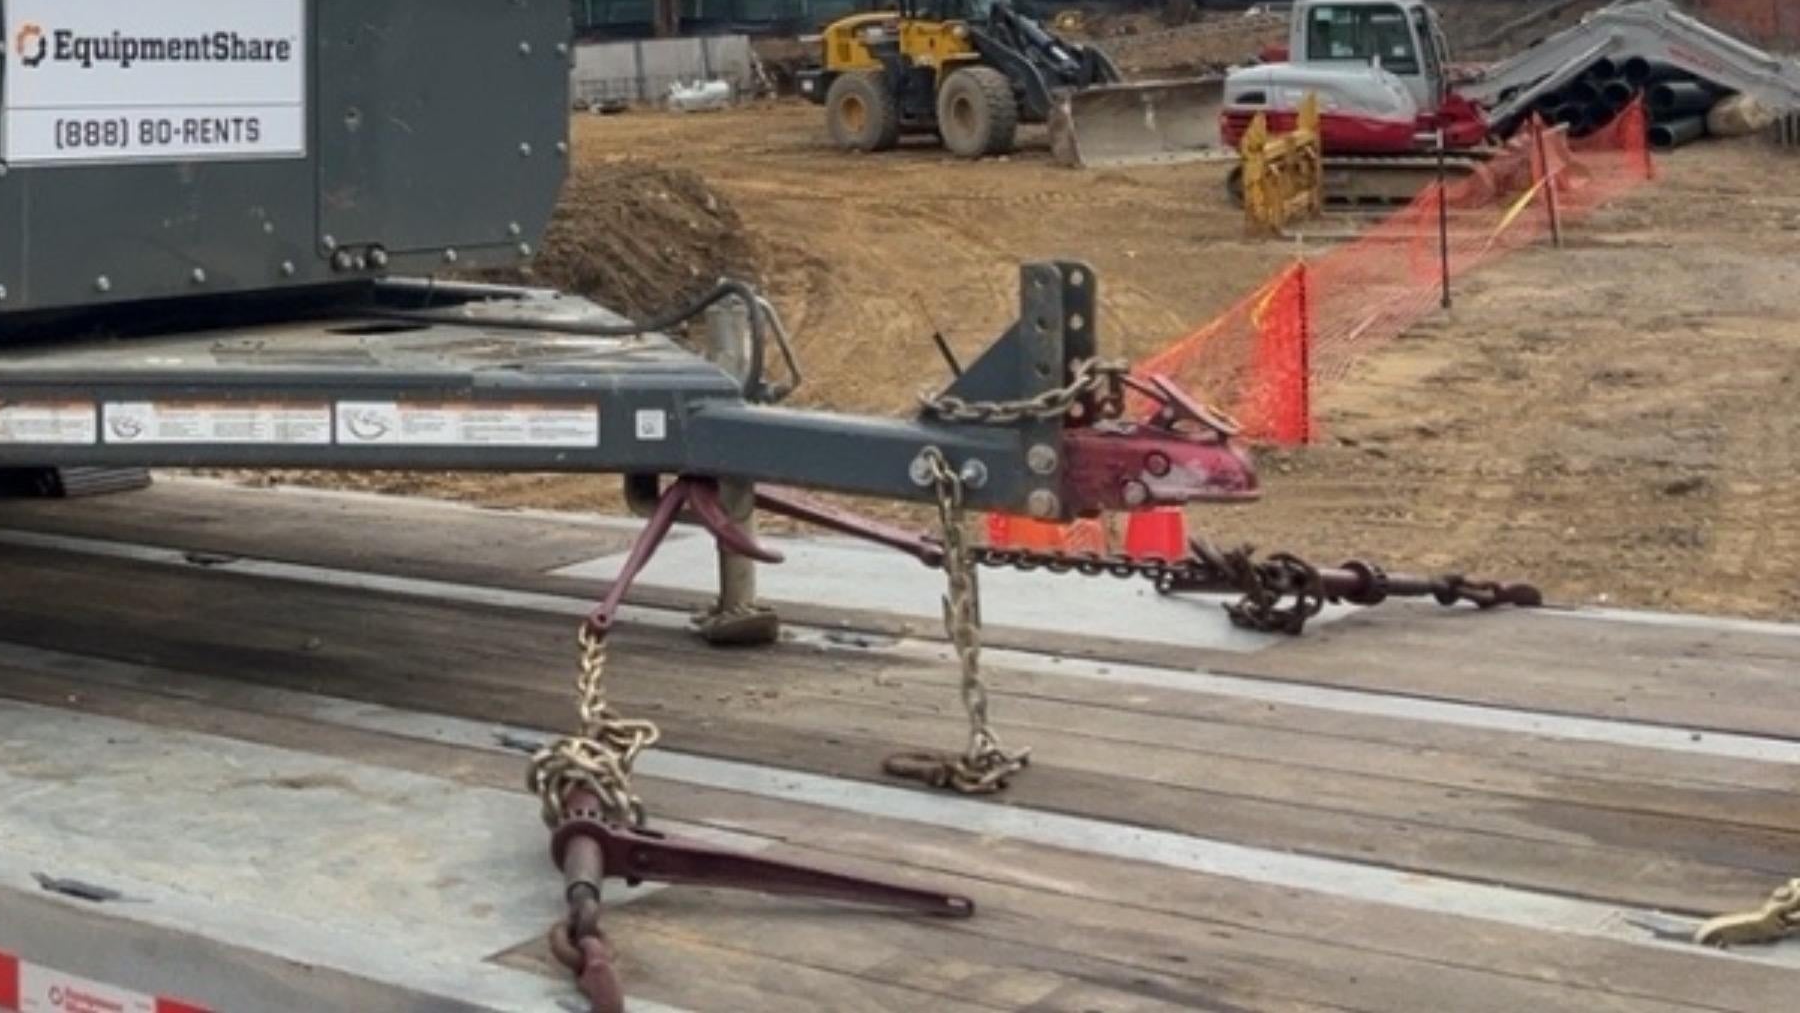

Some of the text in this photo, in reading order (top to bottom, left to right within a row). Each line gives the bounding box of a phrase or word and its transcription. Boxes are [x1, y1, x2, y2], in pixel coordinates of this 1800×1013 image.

[53, 28, 292, 68] EquipmentShare
[54, 117, 261, 150] (888) 80-RENTS
